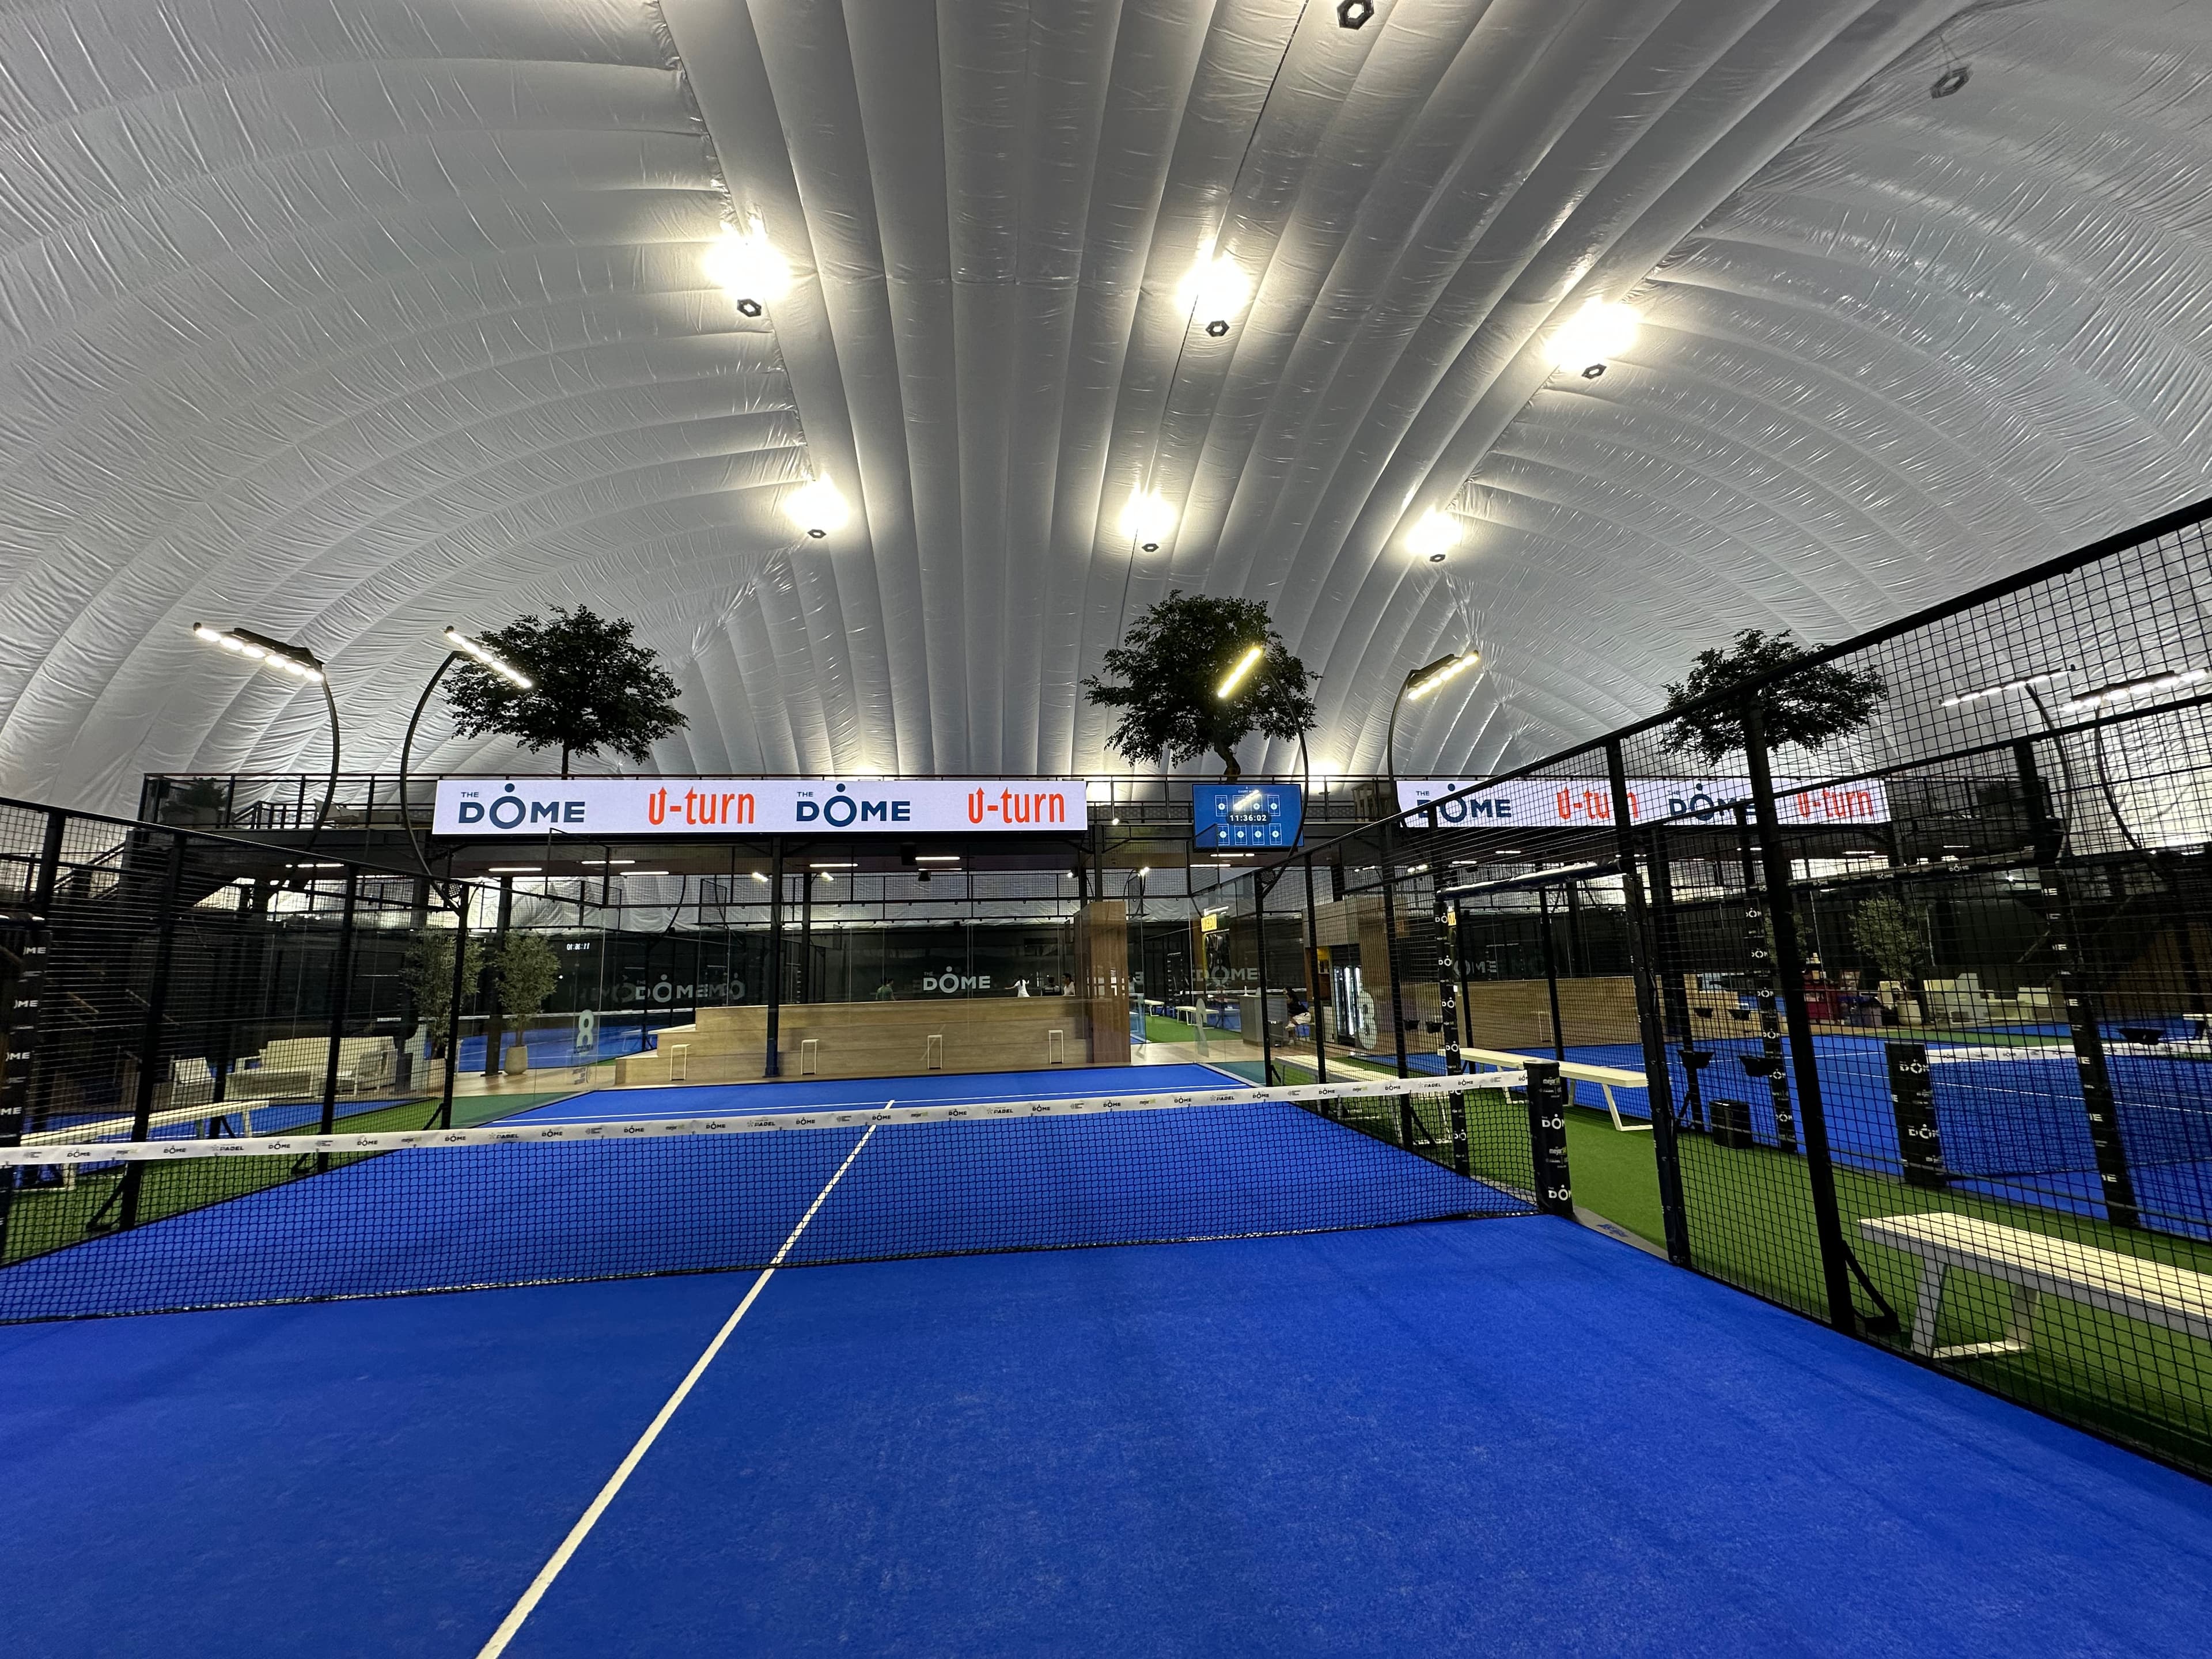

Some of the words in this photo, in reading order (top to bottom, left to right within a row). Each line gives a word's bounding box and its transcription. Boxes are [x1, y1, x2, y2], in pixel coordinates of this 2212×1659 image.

[459, 783, 585, 830] DOME
[648, 786, 755, 825] U-turn
[796, 783, 910, 828] DOME
[968, 787, 1065, 824] U-turn
[1557, 786, 1639, 819] U-tun
[1434, 912, 1448, 923] DO
[23, 946, 47, 955] ME
[1438, 955, 1452, 966] DO
[923, 965, 991, 994] DOME
[14, 999, 39, 1009] ME
[1441, 997, 1456, 1008] DO
[576, 1009, 594, 1056] 8
[1445, 1040, 1460, 1052] DO
[5, 1051, 31, 1062] ME
[268, 1141, 290, 1150] DOME
[357, 1138, 378, 1146] DOME
[445, 1134, 466, 1142] DOME
[541, 1129, 562, 1137] DOME
[624, 1126, 644, 1134] DOME
[796, 1117, 815, 1125] DOME
[948, 1108, 967, 1116] DOME
